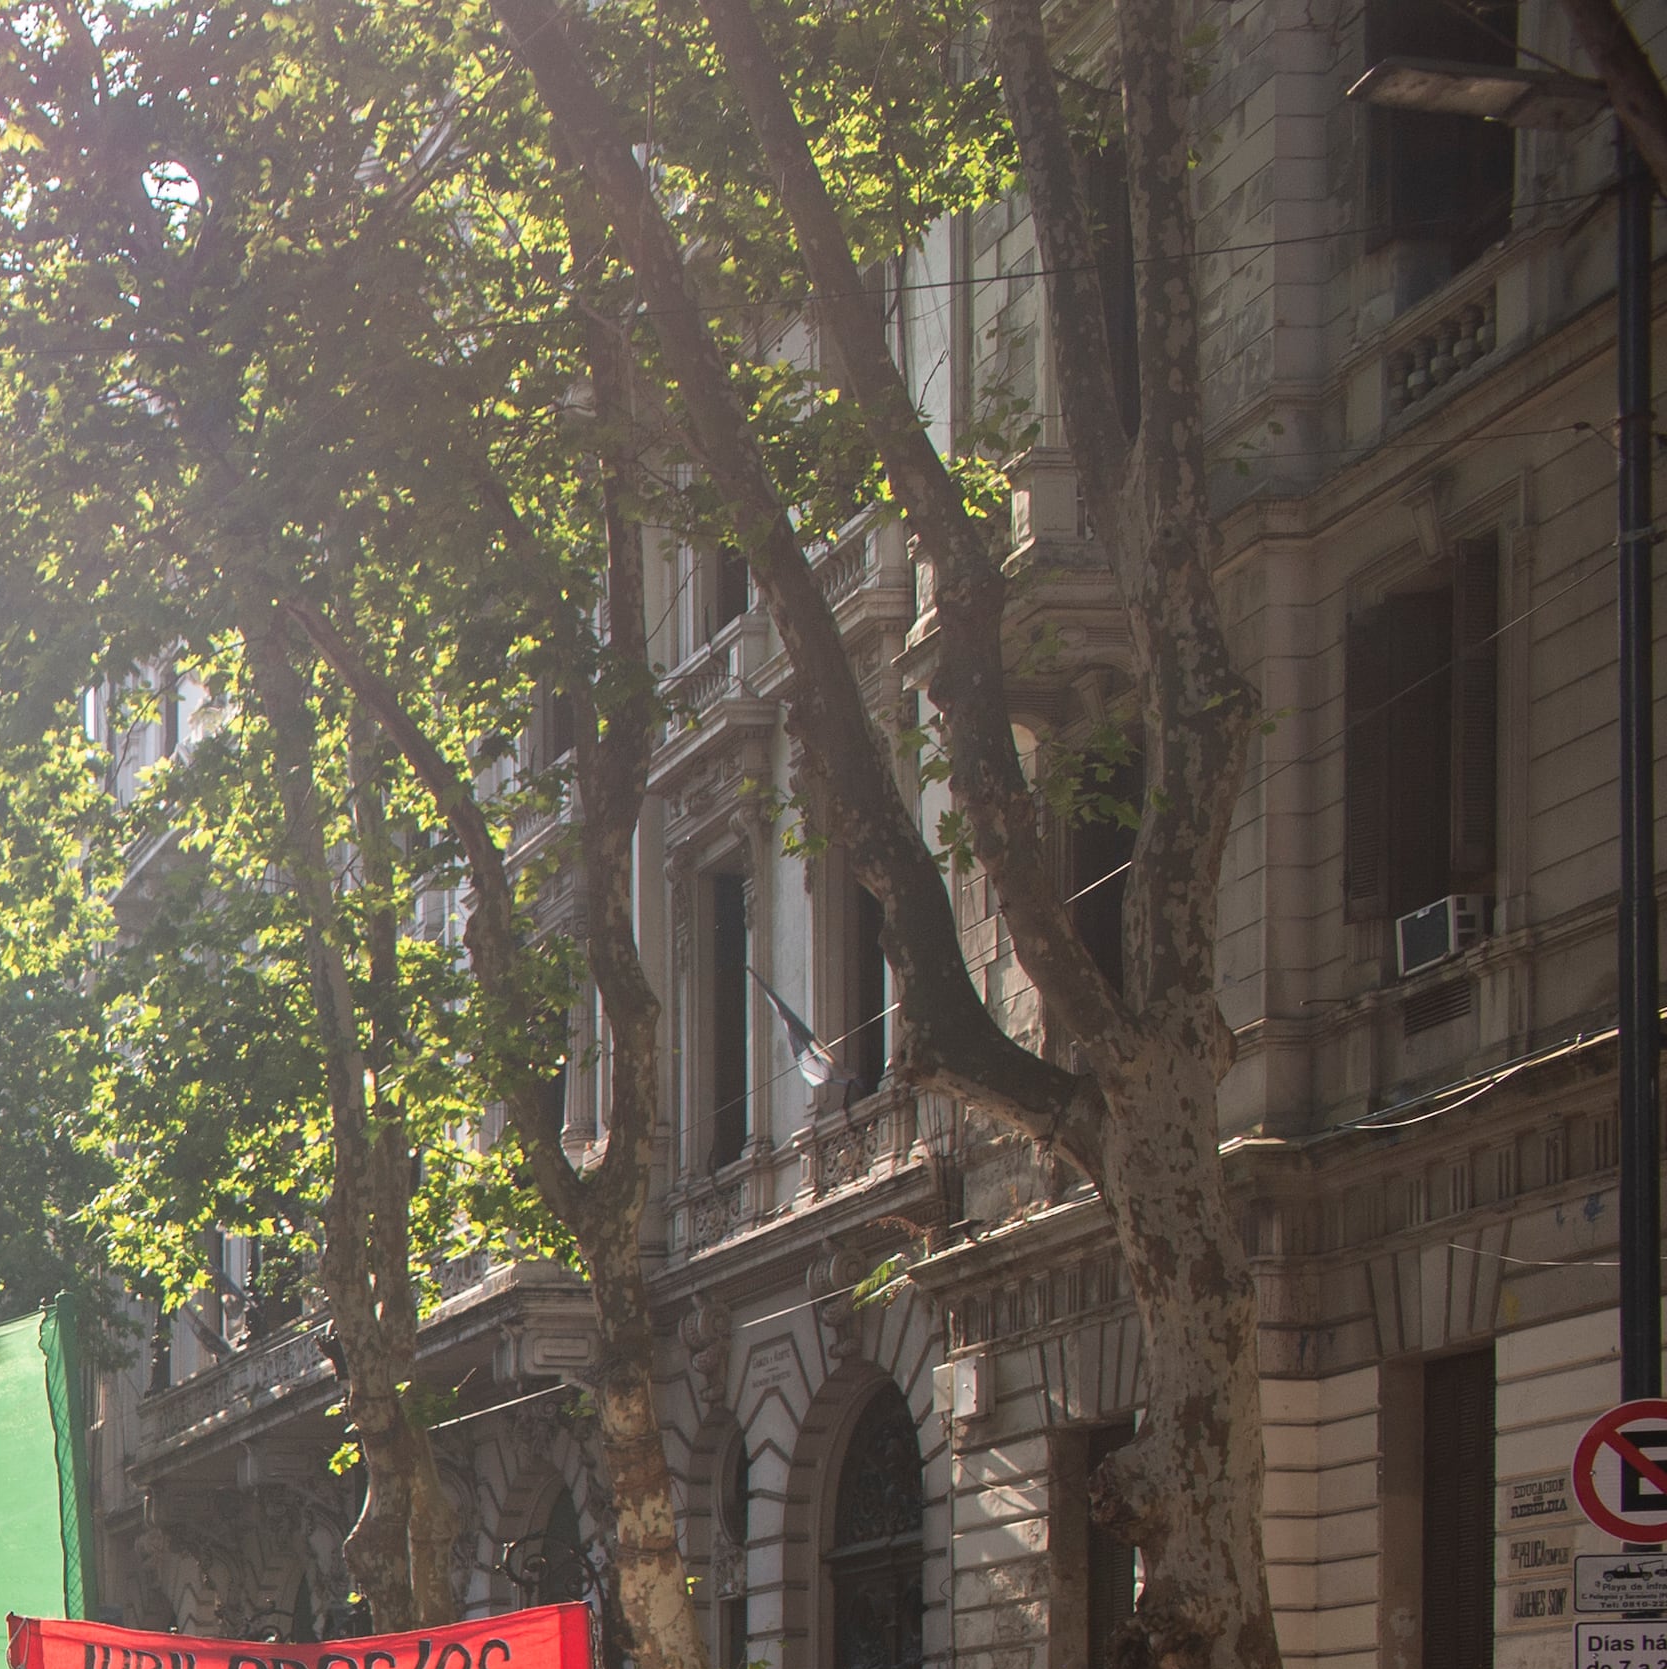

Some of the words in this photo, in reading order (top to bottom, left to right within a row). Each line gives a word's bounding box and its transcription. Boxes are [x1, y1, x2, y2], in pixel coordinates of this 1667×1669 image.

[1602, 1583, 1627, 1593] Playa
[1630, 1583, 1643, 1591] de
[1588, 1635, 1635, 1652] Días
